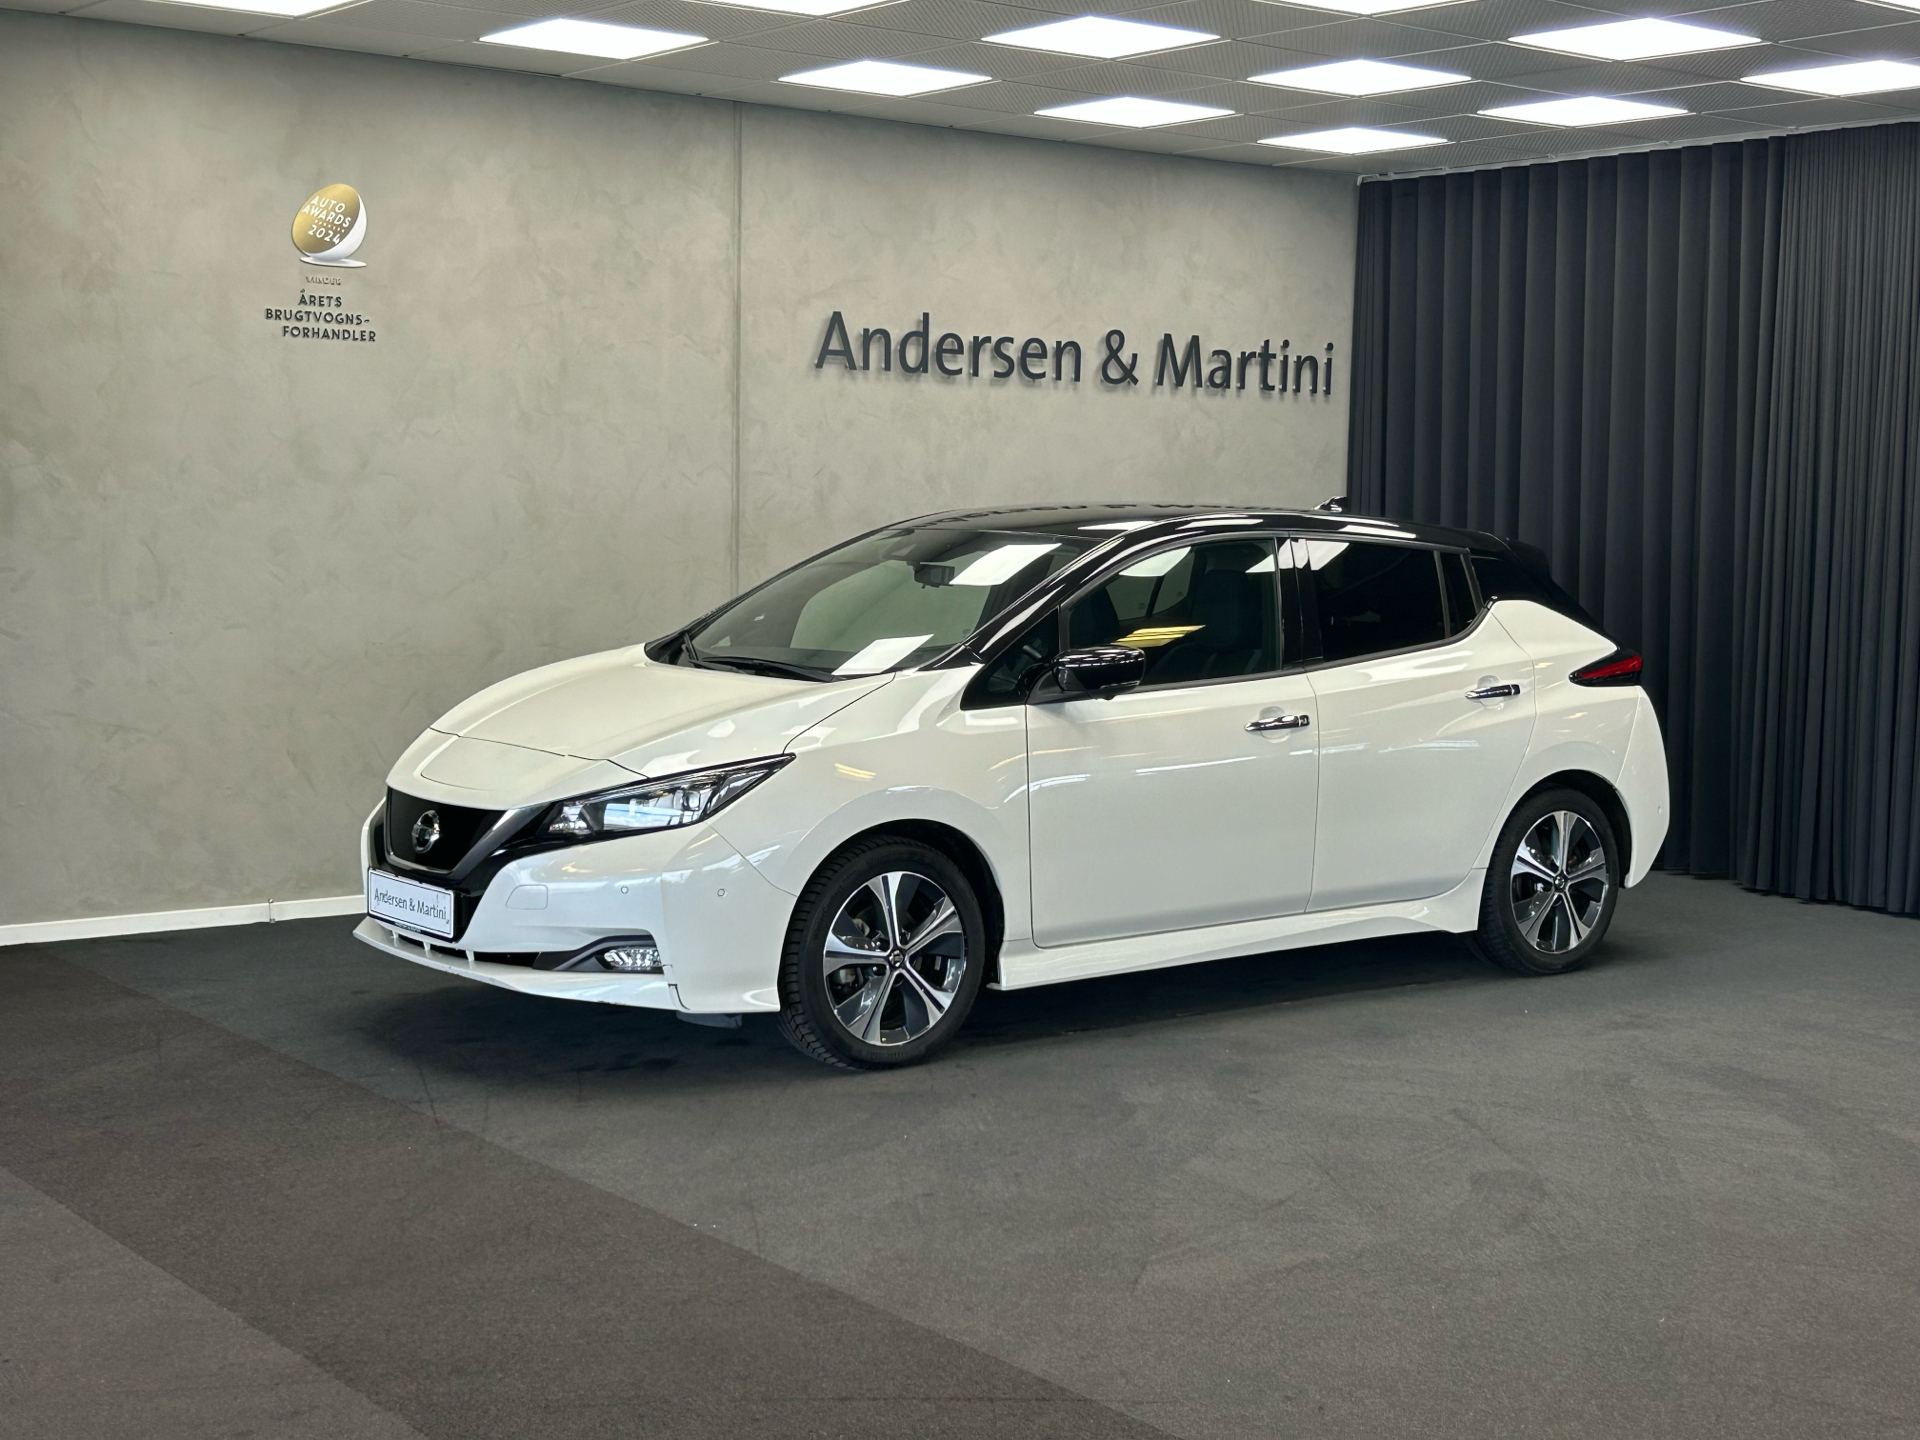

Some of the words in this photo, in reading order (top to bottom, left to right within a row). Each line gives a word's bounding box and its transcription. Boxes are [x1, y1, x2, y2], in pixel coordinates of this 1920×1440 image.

[310, 195, 346, 213] AUTO
[301, 204, 352, 228] AWARDS
[308, 224, 340, 245] 2024
[297, 288, 342, 308] ÅRETS
[265, 308, 370, 326] BRUGTVOGNS-
[282, 325, 376, 342] FORHANDLER
[815, 311, 1083, 383] Andersen
[1100, 329, 1139, 386] &
[1156, 333, 1334, 395] Martini
[374, 888, 407, 909] Andersen
[408, 898, 416, 912] &
[416, 900, 447, 920] Martini
